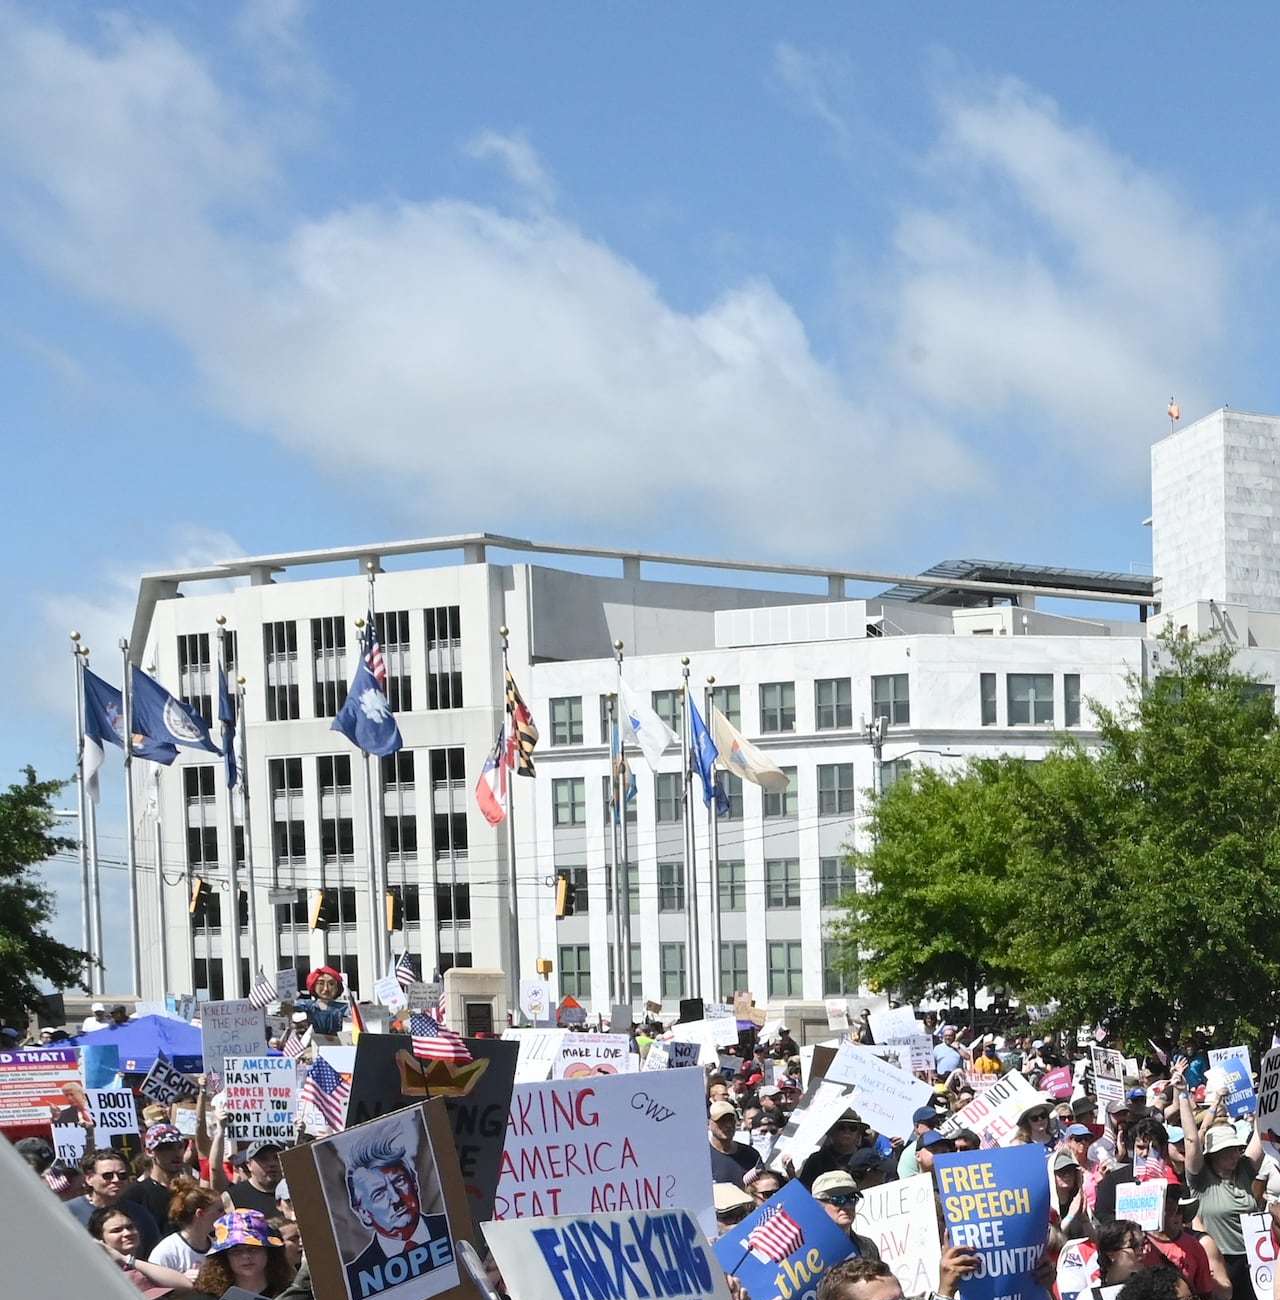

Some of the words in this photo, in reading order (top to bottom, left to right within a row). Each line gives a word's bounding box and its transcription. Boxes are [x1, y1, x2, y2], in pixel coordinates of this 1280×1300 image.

[212, 1019, 231, 1029] THE
[234, 1016, 258, 1027] KING
[244, 1042, 260, 1054] UP
[561, 1047, 590, 1059] MAKE
[595, 1047, 623, 1058] LOVE
[226, 1058, 237, 1070] IF
[242, 1058, 292, 1070] AMERICA
[226, 1072, 270, 1084] HASN'T
[1262, 1072, 1278, 1093] NO
[100, 1092, 132, 1110] BOOT
[226, 1088, 266, 1098] BROKEN
[268, 1088, 292, 1098] YOUR
[969, 1100, 989, 1124] DO
[984, 1074, 1018, 1105] NOT
[270, 1100, 289, 1110] YOU
[1258, 1090, 1277, 1117] NO
[100, 1112, 132, 1128] ASS!
[227, 1112, 261, 1123] DON'T
[266, 1112, 293, 1123] LOVE
[227, 1125, 250, 1138] HER
[253, 1124, 294, 1137] ENOUGH
[499, 1137, 639, 1184] AMERICA
[940, 1163, 995, 1193] FREE
[591, 1174, 677, 1213] AGAIN?
[946, 1188, 1030, 1222] SPEECH
[951, 1221, 1005, 1249] FREE
[356, 1238, 453, 1297] NOPE
[773, 1244, 824, 1300] the
